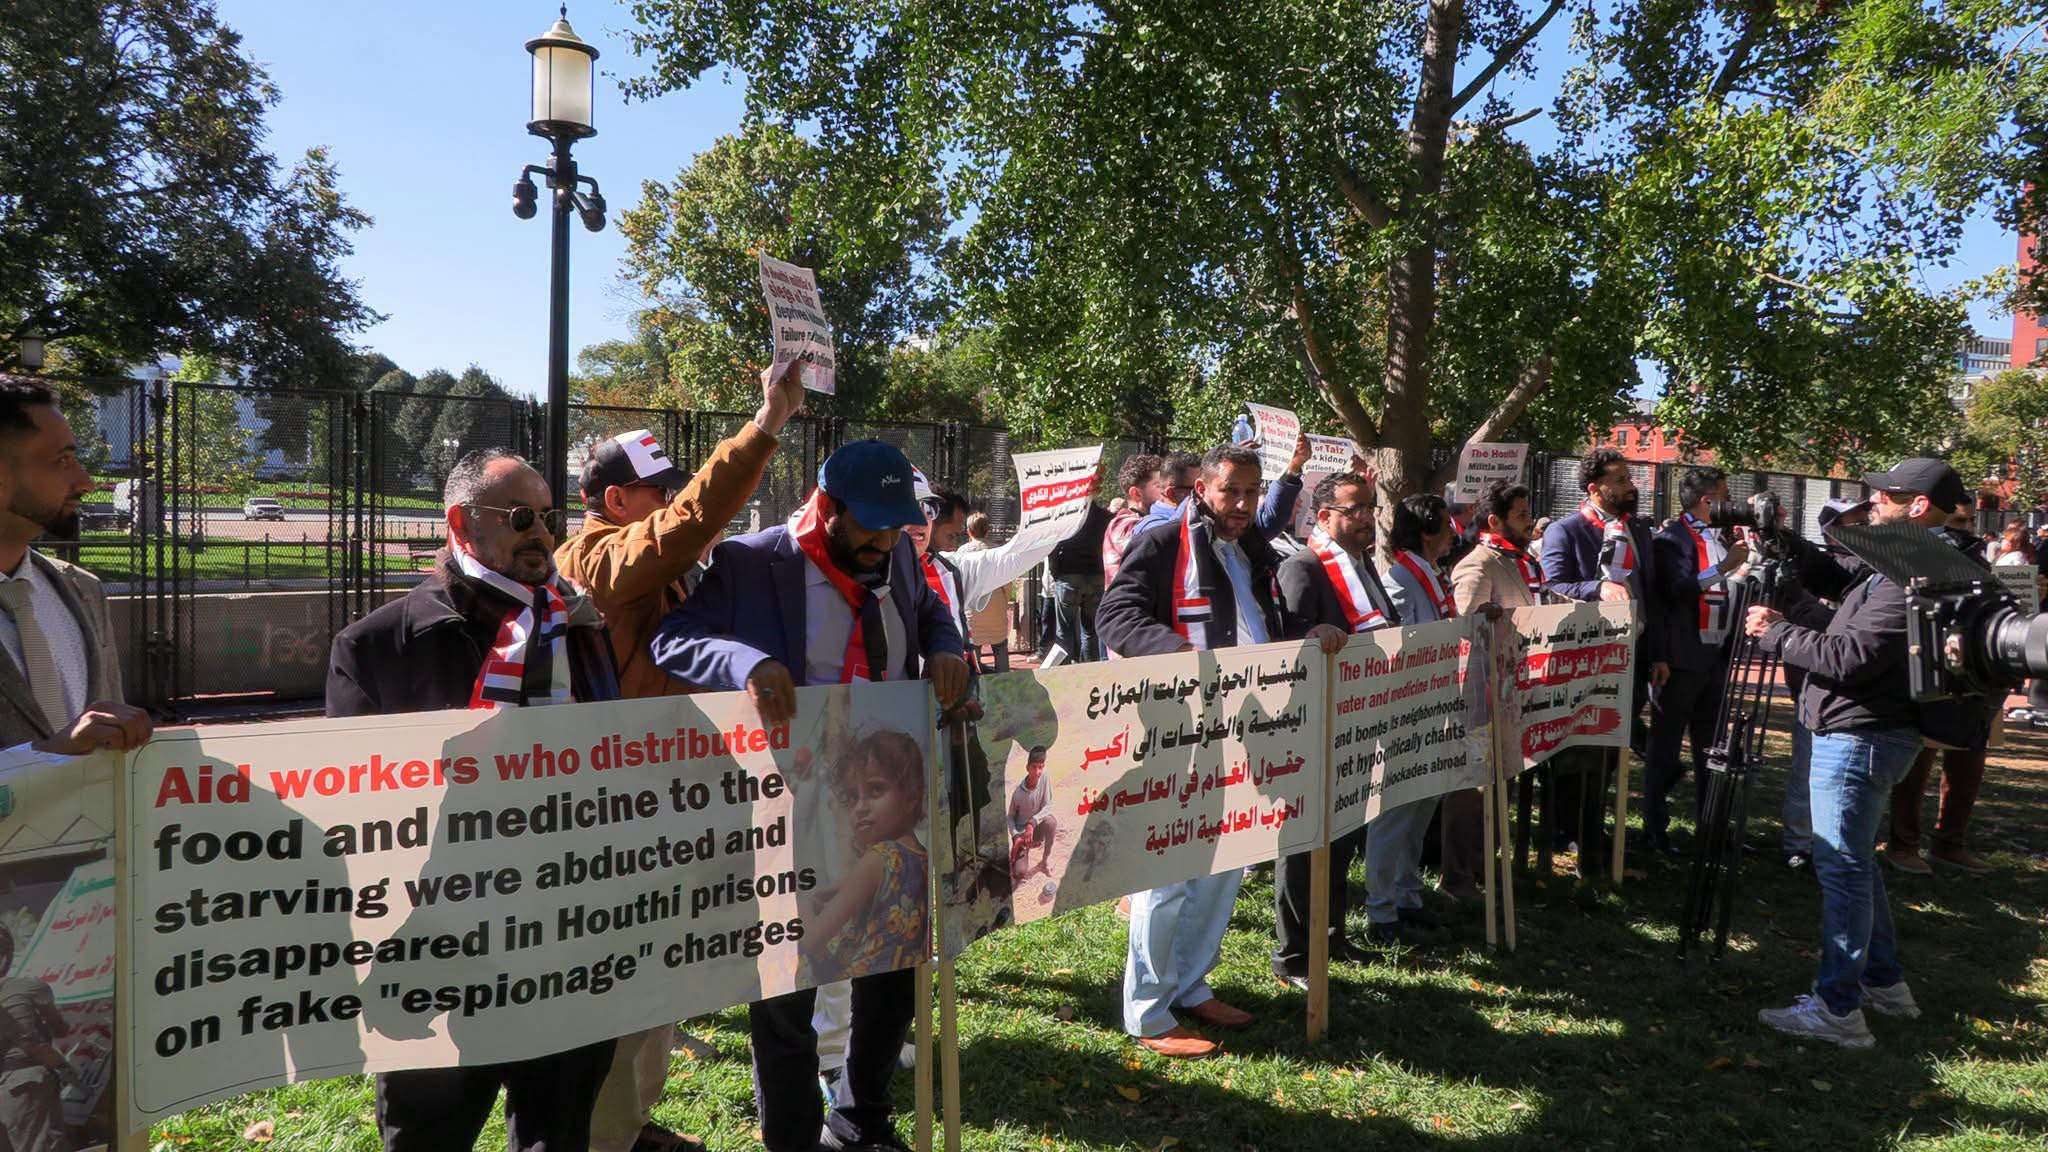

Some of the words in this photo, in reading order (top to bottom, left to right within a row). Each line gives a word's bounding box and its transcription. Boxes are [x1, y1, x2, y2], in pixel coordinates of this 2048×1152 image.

[781, 326, 806, 342] failure
[1305, 463, 1336, 473] patients
[1315, 445, 1323, 453] of
[1325, 445, 1345, 455] Taiz
[1320, 455, 1349, 466] kidney
[1472, 449, 1489, 458] The
[1491, 449, 1519, 459] Houthi
[1465, 474, 1482, 483] the
[1999, 571, 2031, 580] Houthi
[1257, 658, 1308, 692] مليشيا
[1339, 660, 1361, 682] The
[1364, 650, 1405, 678] Houthi
[1406, 644, 1438, 669] militia
[1438, 639, 1471, 662] blocks
[1557, 656, 1573, 675] منذ
[1086, 677, 1150, 721] المزارع
[1153, 673, 1200, 705] حولت
[1203, 663, 1253, 707] الحوثي
[1336, 695, 1366, 717] water
[1369, 688, 1391, 709] and
[1391, 678, 1429, 702] medicine
[1430, 673, 1451, 691] from
[1161, 713, 1245, 750] والطرقات
[1248, 703, 1307, 737] اليمنية
[1334, 727, 1352, 750] and
[1355, 719, 1389, 743] bombs
[1400, 697, 1469, 727] neighborhoods,
[1079, 723, 1129, 771] أكبر
[1132, 725, 1157, 762] إلى
[1335, 754, 1354, 786] yet
[1424, 722, 1466, 747] chants
[154, 764, 250, 808] Aid
[270, 754, 480, 800] workers
[494, 744, 580, 782] who
[590, 721, 791, 772] distributed
[1202, 752, 1251, 800] ألغام
[1253, 749, 1306, 787] حقول
[1334, 787, 1360, 814] about
[1361, 779, 1384, 802] lifting
[1384, 762, 1429, 790] blockades
[1430, 751, 1467, 774] abroad
[1077, 786, 1110, 816] منذ
[1111, 772, 1177, 817] العالم
[1178, 762, 1199, 810] في
[154, 818, 303, 871] food
[322, 806, 429, 858] and
[447, 786, 659, 844] medicine
[669, 777, 711, 813] to
[720, 768, 785, 804] the
[1197, 805, 1258, 844] العالمية
[1261, 794, 1305, 831] الحرب
[1145, 818, 1193, 856] الثانية
[153, 877, 390, 934] starving
[404, 867, 522, 908] were
[535, 828, 716, 890] abducted
[725, 816, 787, 855] and
[154, 920, 490, 997] disappeared
[504, 915, 543, 952] in
[557, 884, 683, 942] Houthi
[691, 866, 818, 919] prisons
[154, 1011, 221, 1058] on
[237, 991, 363, 1036] fake
[380, 942, 654, 1017] "espionage"
[663, 916, 806, 969] charges
